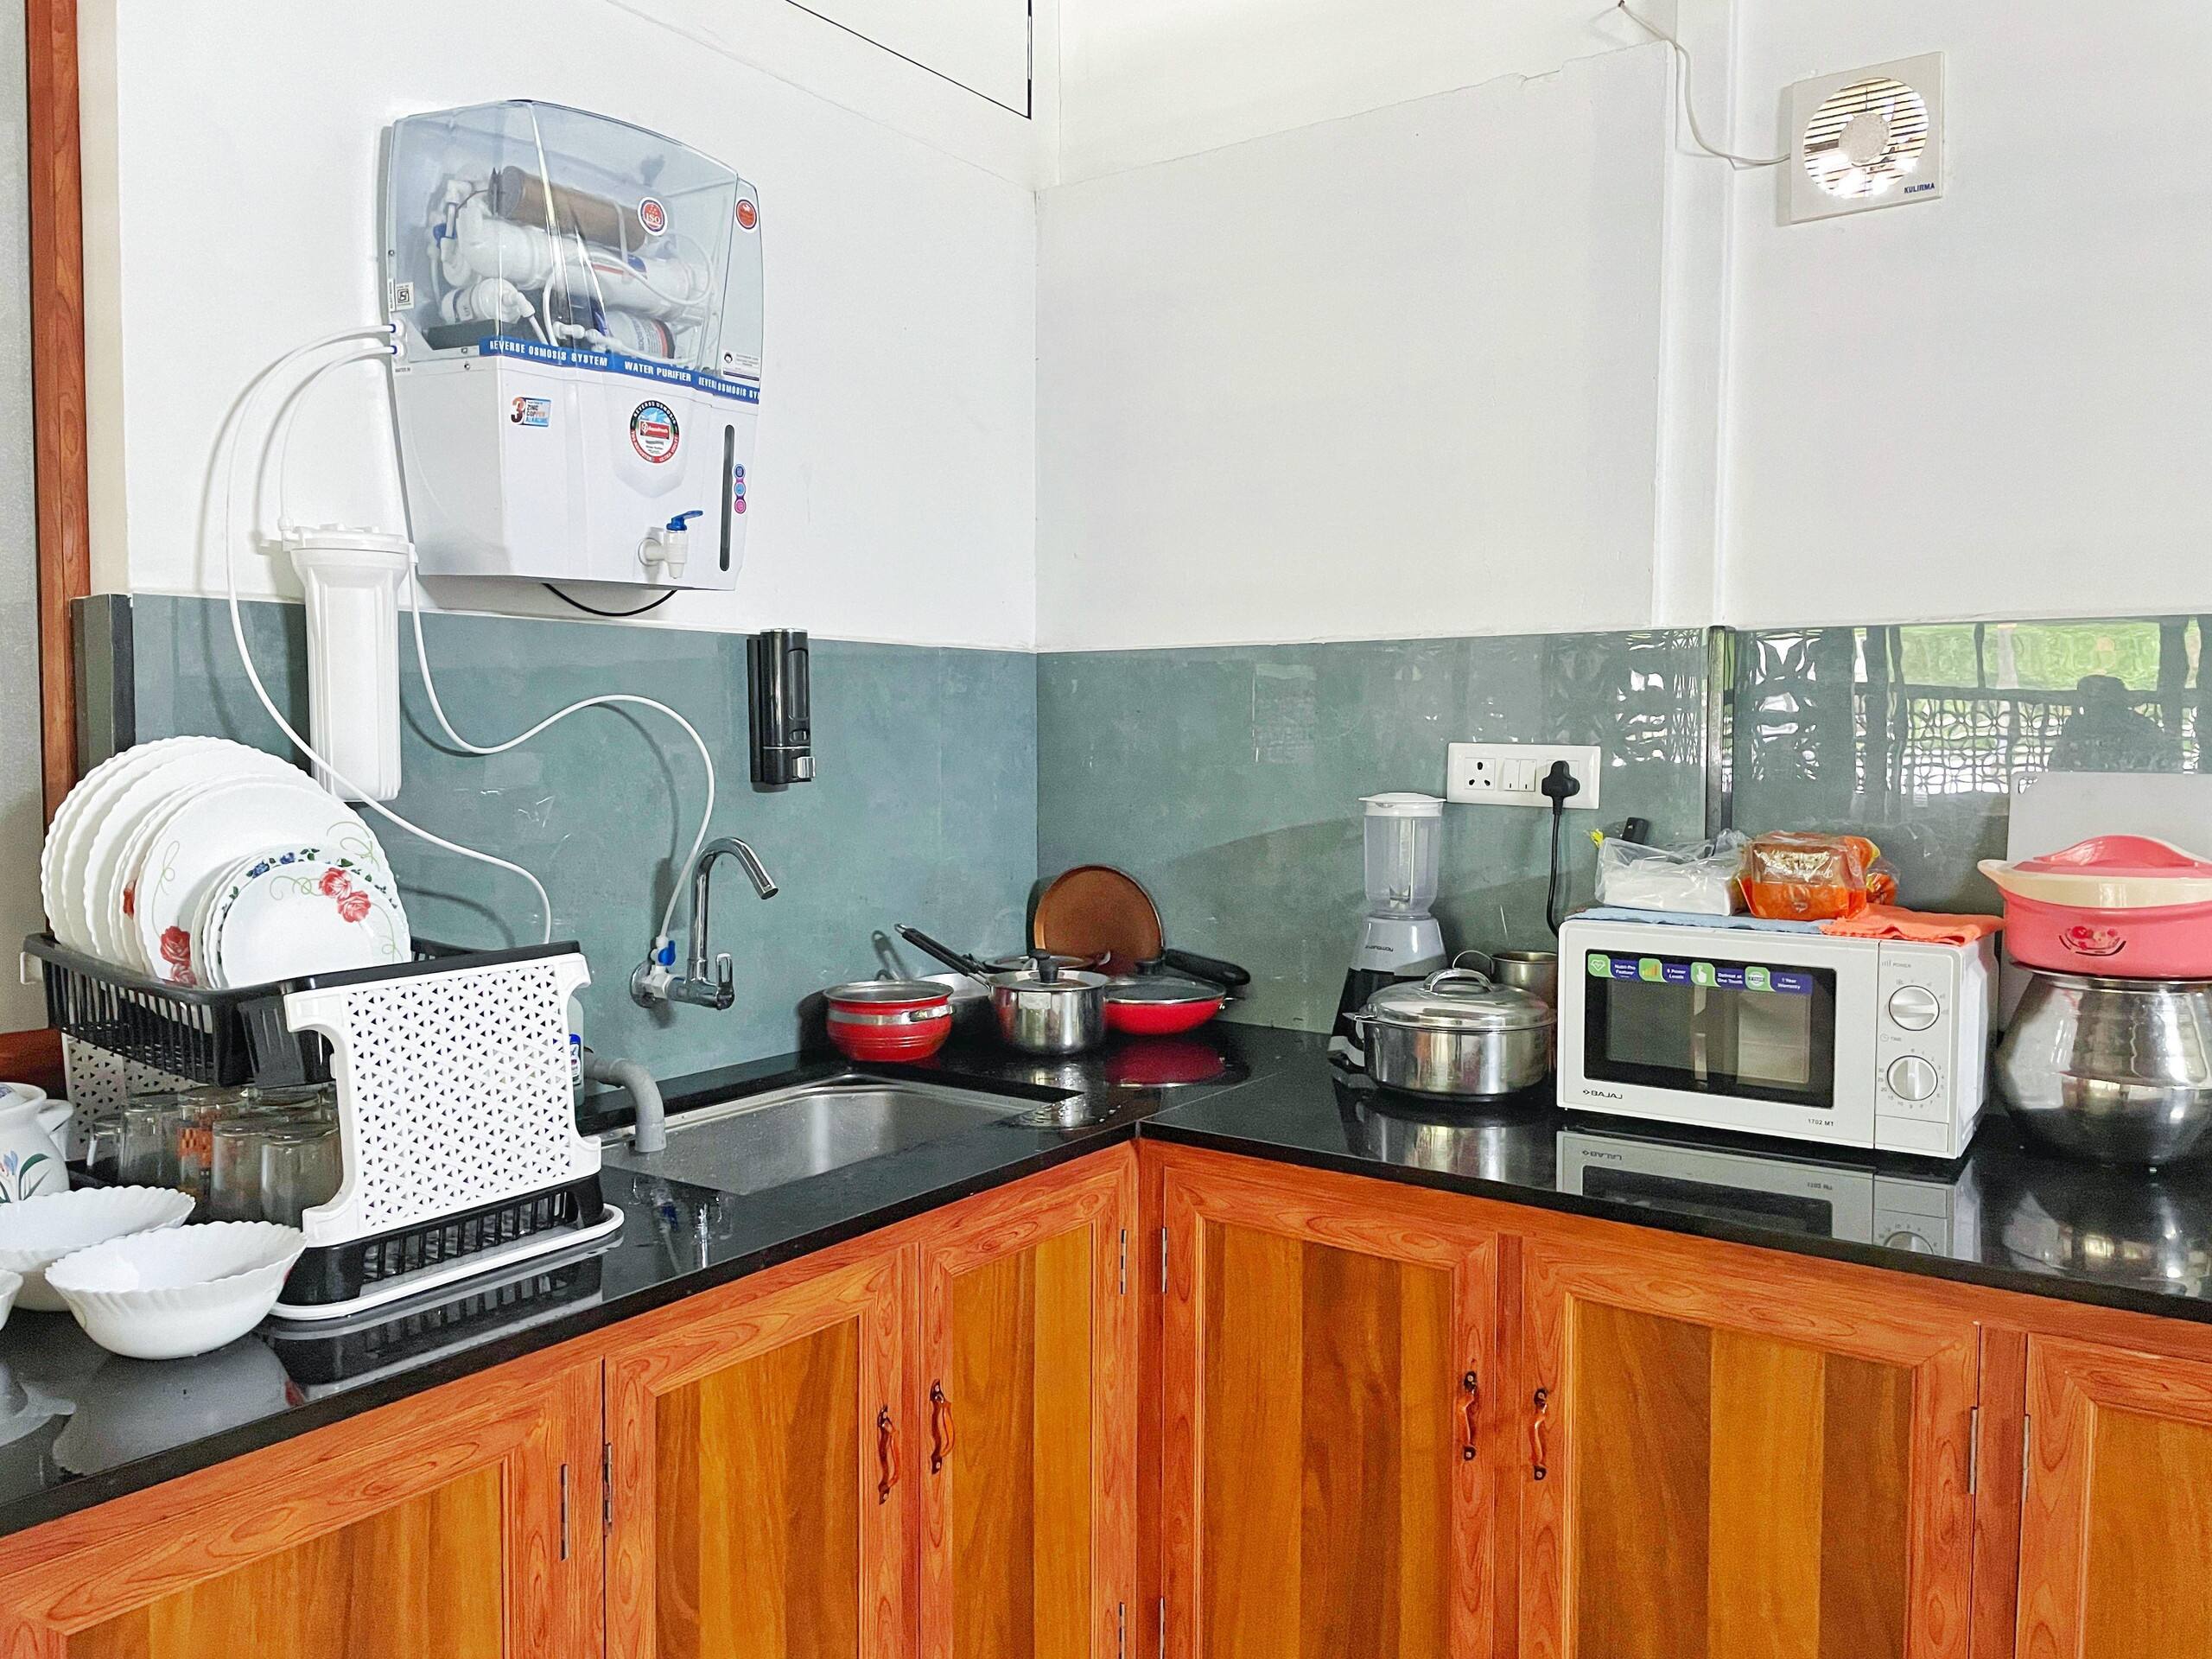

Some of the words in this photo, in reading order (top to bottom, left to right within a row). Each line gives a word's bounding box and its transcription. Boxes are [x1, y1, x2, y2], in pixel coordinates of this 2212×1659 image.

[646, 213, 660, 224] ISO
[490, 340, 525, 353] REVERSE
[529, 346, 567, 361] OSMOSIS
[571, 353, 608, 366] SYSTEM
[624, 360, 654, 375] WATER
[657, 367, 691, 382] PURIFIER
[718, 382, 747, 397] OSMOSIS
[1591, 1090, 1623, 1100] BAJAJ
